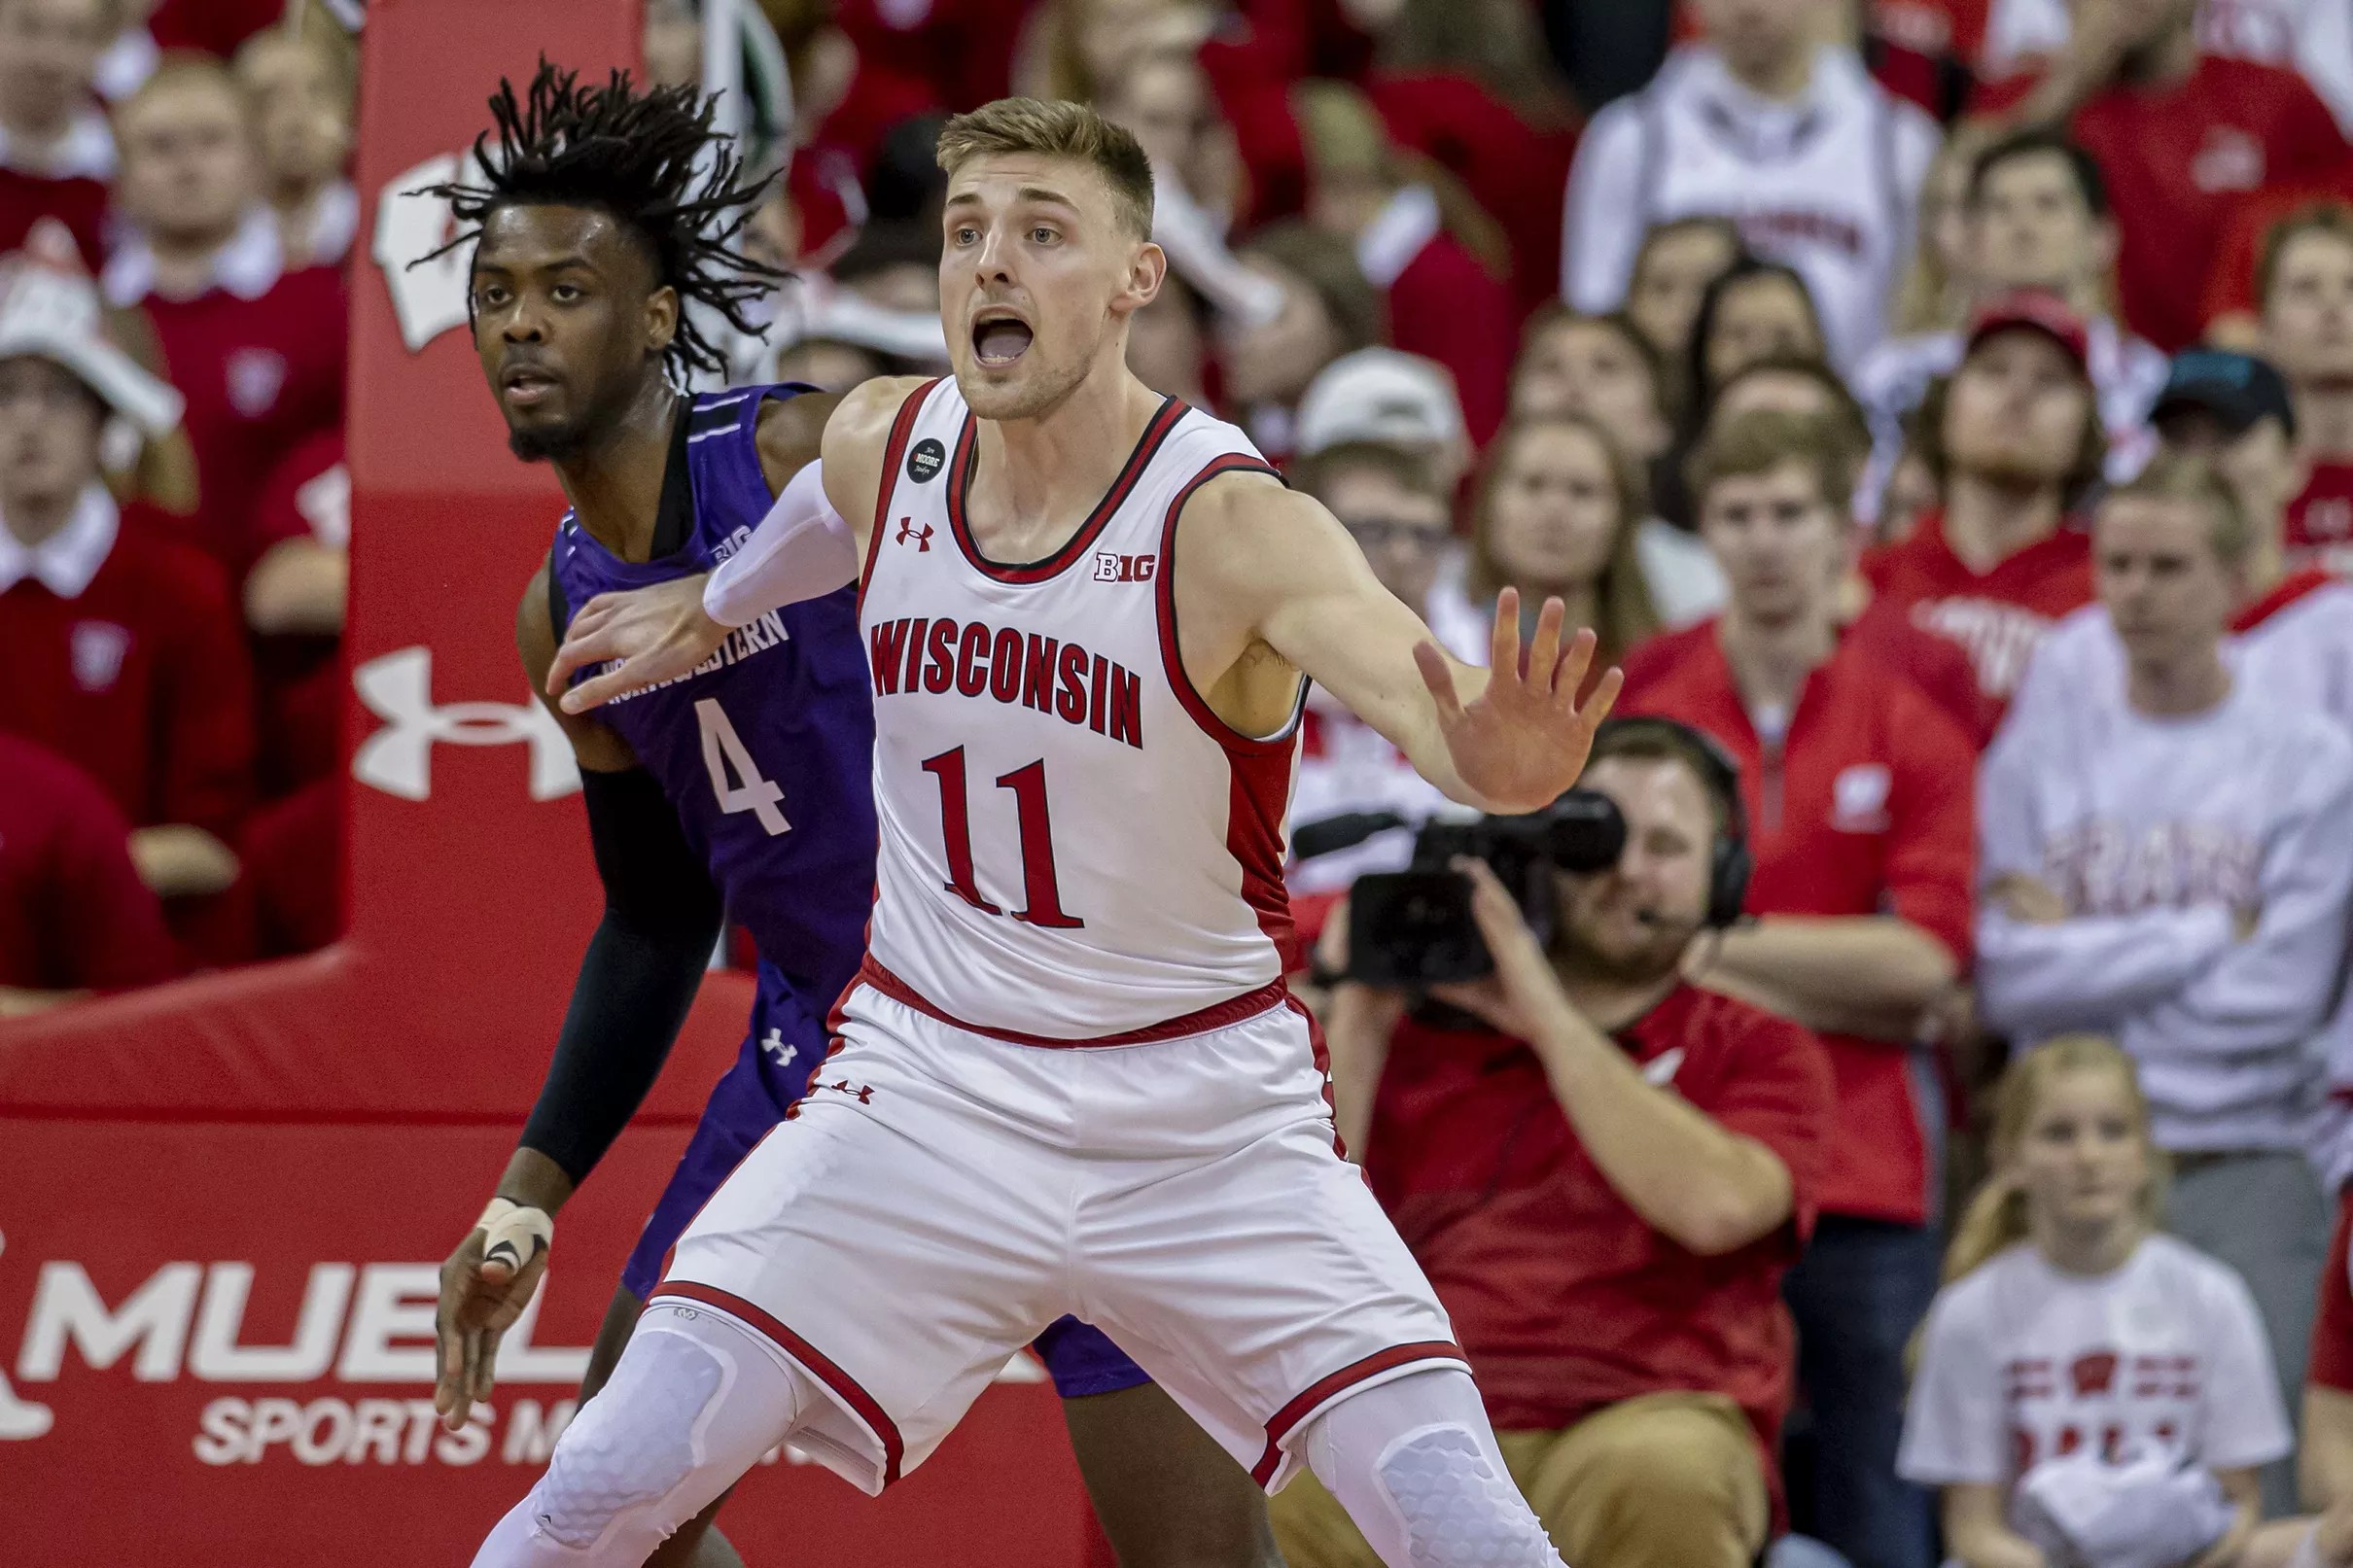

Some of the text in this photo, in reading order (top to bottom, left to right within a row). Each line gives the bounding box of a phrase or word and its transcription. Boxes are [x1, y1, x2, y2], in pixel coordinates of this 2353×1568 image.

[916, 453, 940, 467] MOORE
[871, 618, 1143, 750] WISCONSIN
[694, 698, 792, 836] 4
[922, 745, 1084, 928] 11
[17, 1261, 595, 1383] MUEL
[193, 1397, 497, 1465] SPORTS
